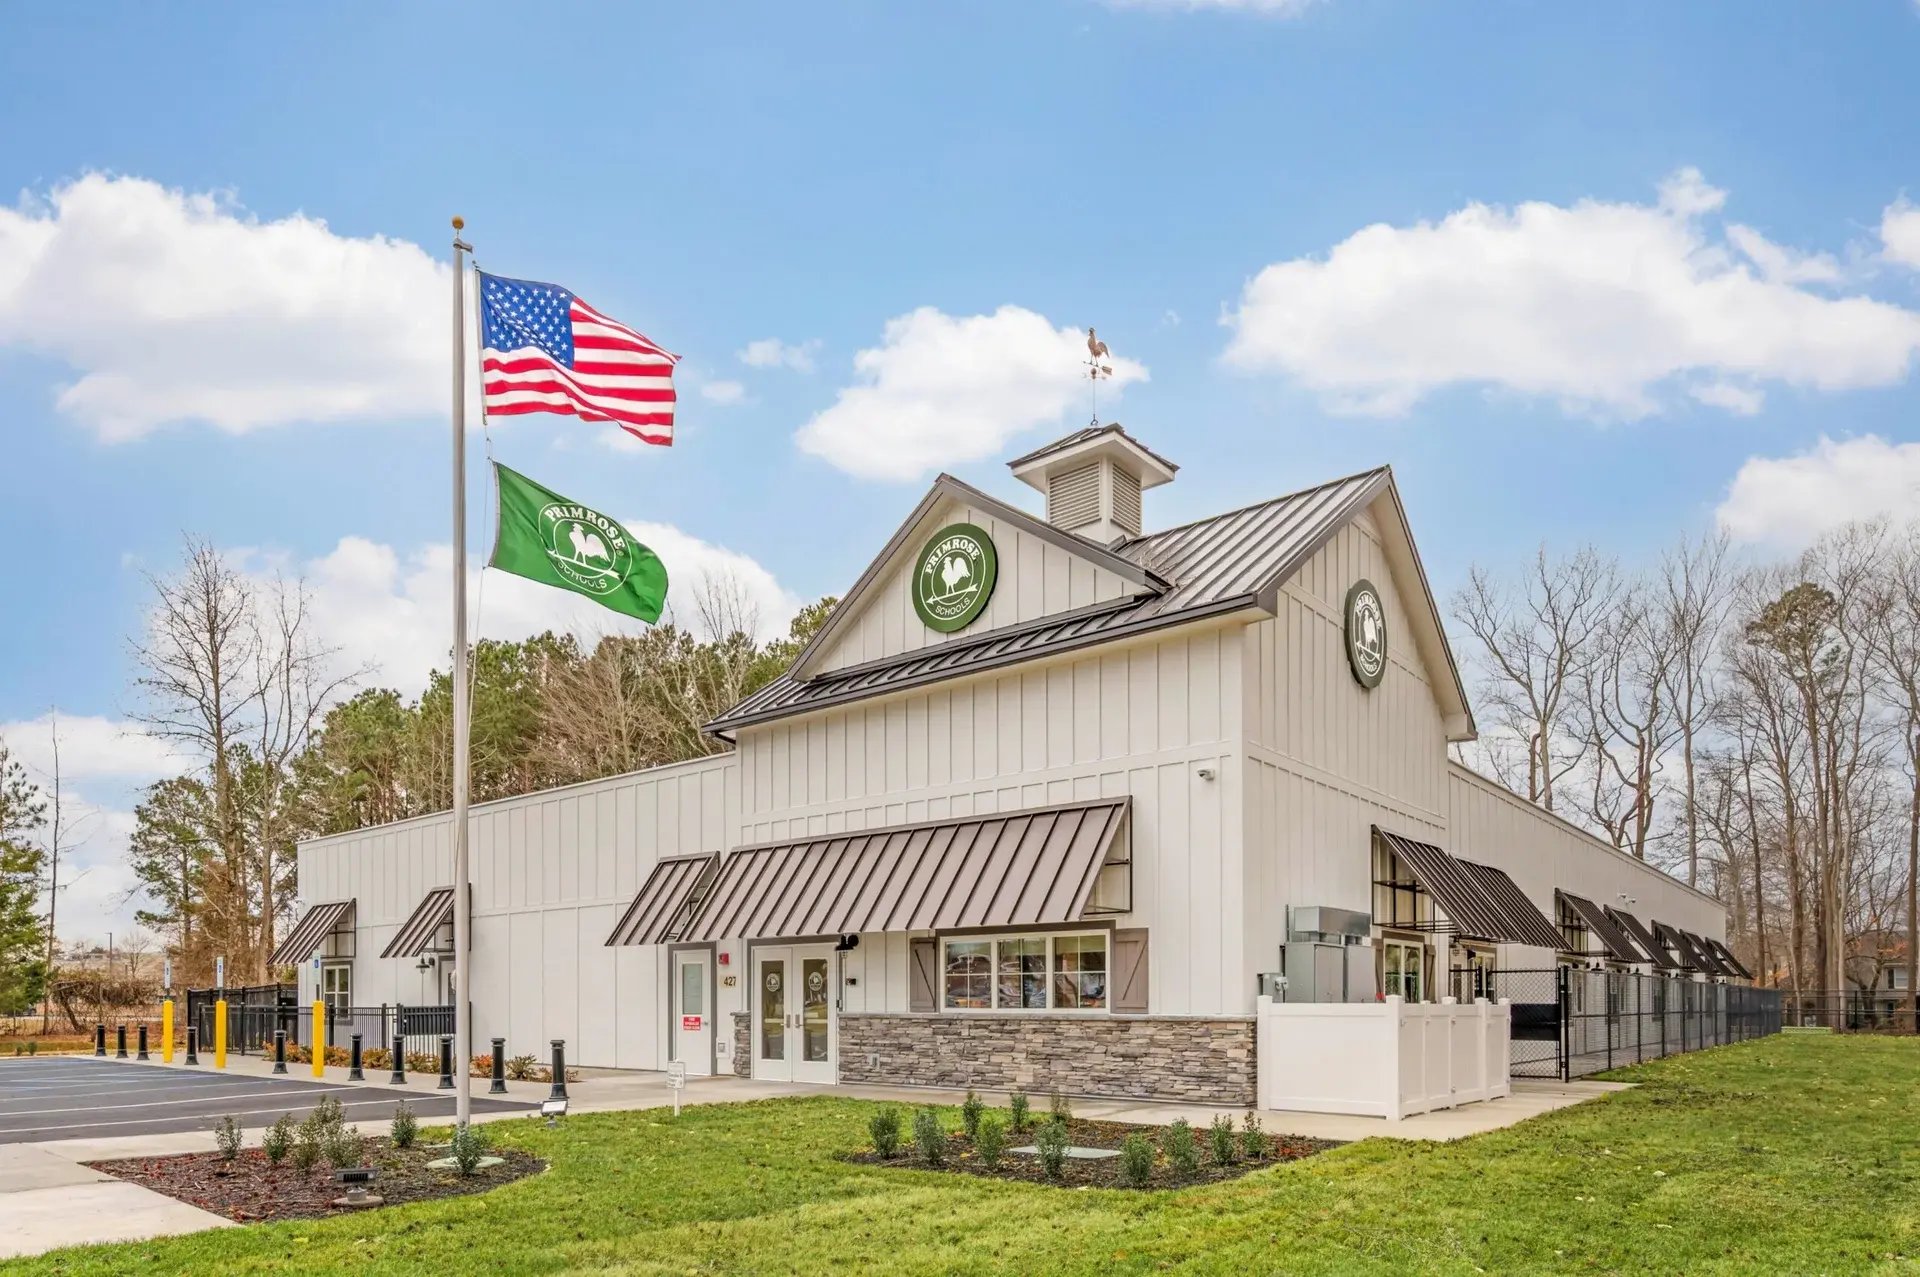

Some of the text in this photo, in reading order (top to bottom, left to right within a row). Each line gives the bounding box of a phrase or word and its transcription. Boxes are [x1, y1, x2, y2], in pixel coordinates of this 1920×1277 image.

[544, 506, 626, 549] PRIMROSE
[925, 538, 980, 574] PRIMROSE
[935, 597, 971, 616] SCHOOLS
[723, 976, 737, 987] 427
